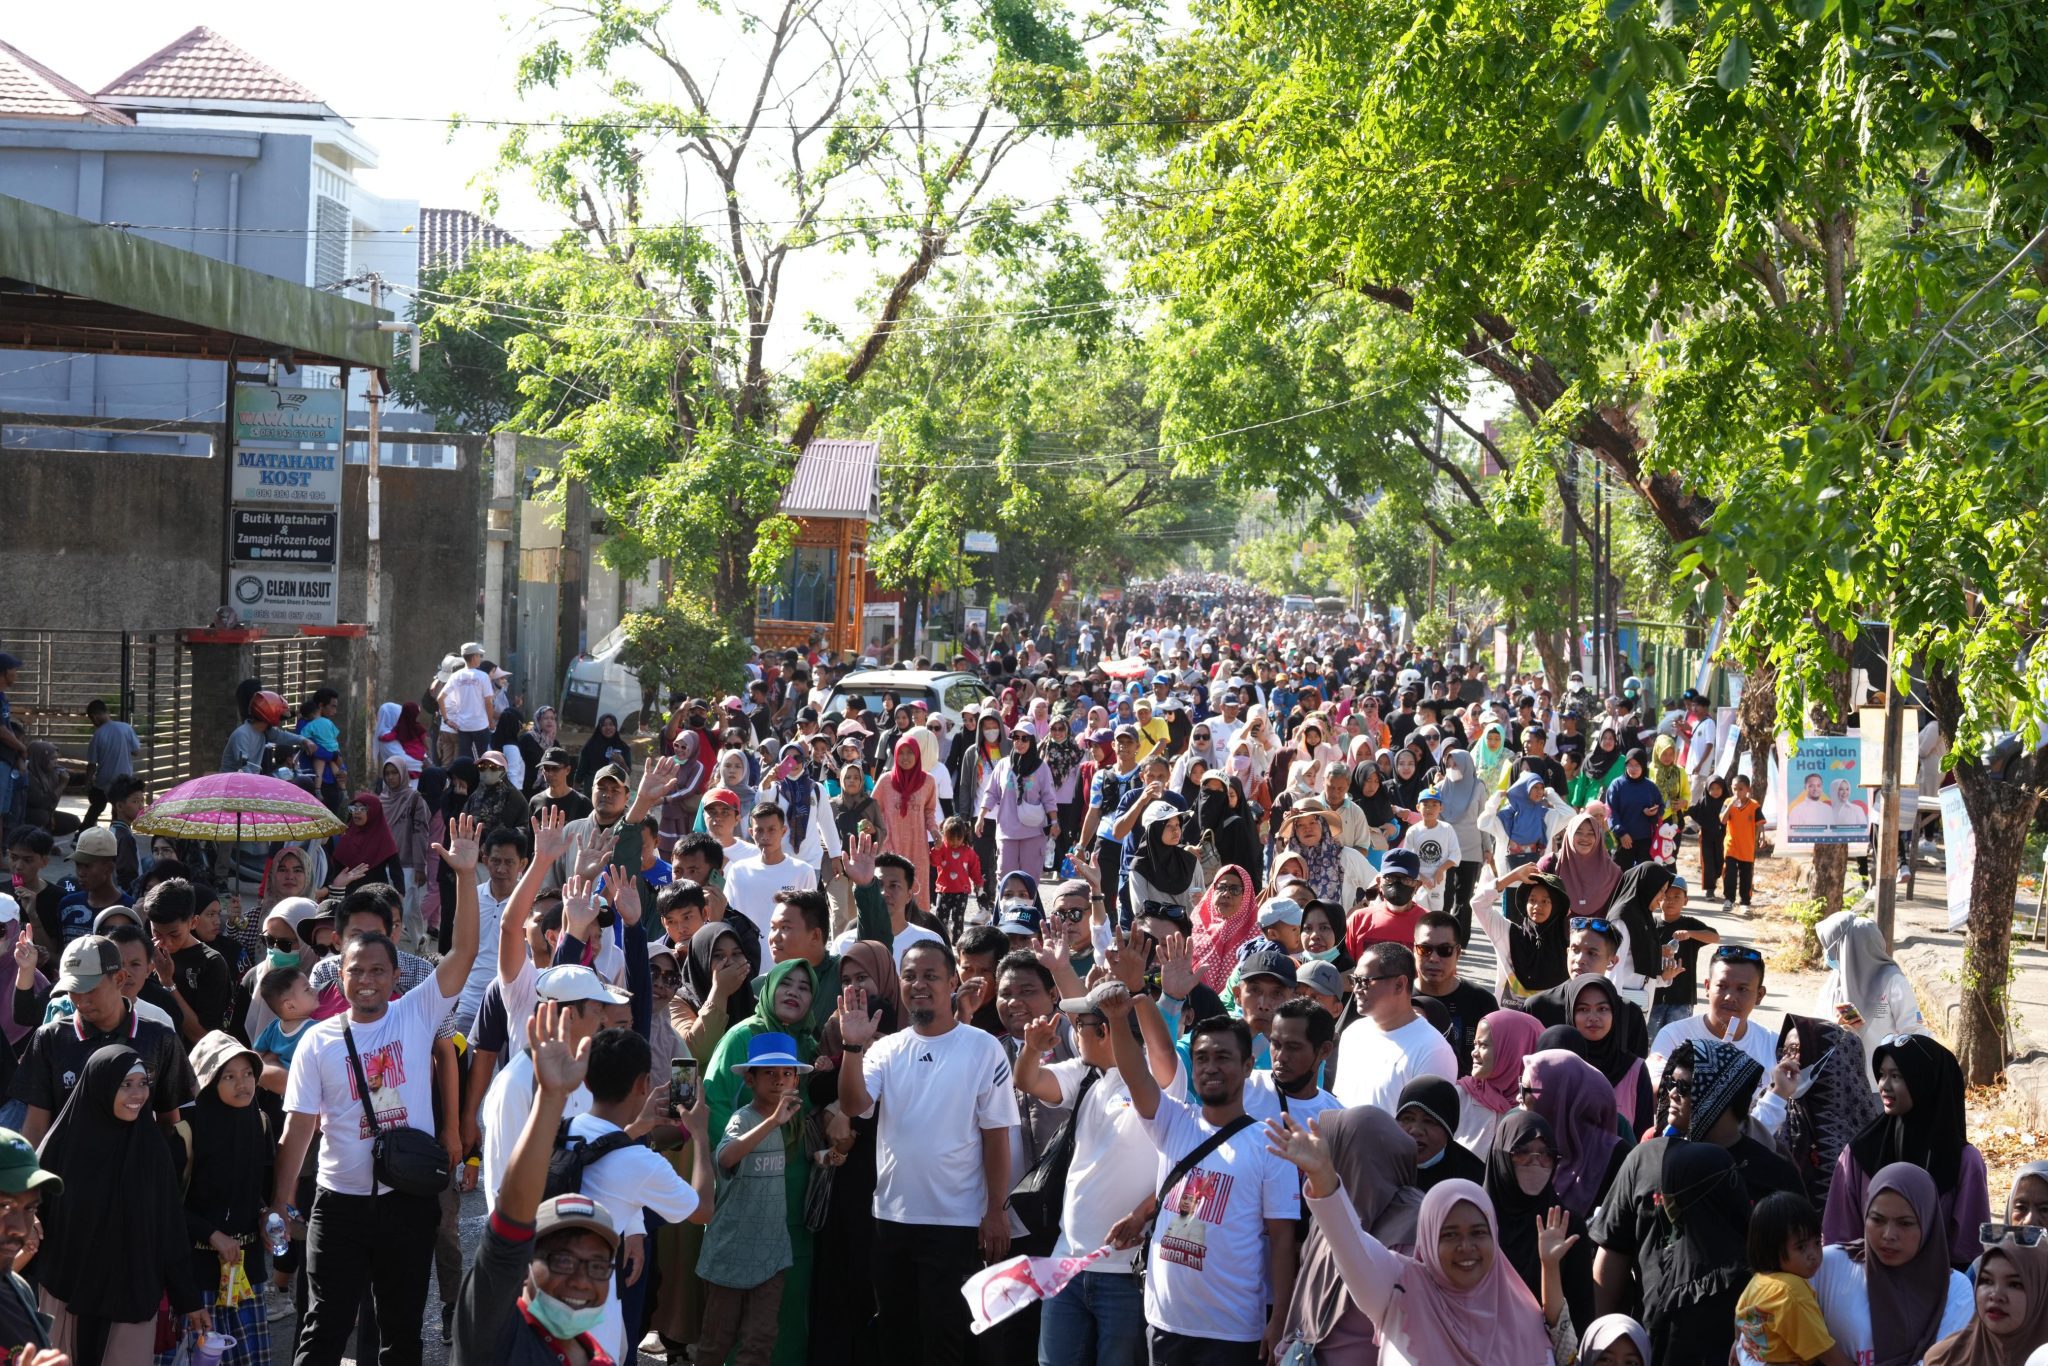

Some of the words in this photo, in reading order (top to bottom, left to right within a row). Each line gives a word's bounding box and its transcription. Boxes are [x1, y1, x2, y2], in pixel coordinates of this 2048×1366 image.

[237, 453, 335, 471] MATAHARI
[259, 470, 311, 487] KOST
[242, 513, 271, 524] Butik
[274, 514, 327, 526] Matahari
[280, 525, 288, 535] &
[237, 533, 272, 546] Zamagi
[274, 534, 306, 545] Frozen
[308, 535, 331, 546] Food
[266, 580, 296, 597] CLEAN
[298, 581, 331, 598] KASUT
[1796, 746, 1856, 757] Andalan
[1797, 759, 1826, 770] Hati
[1161, 1235, 1206, 1258] SAHABAT
